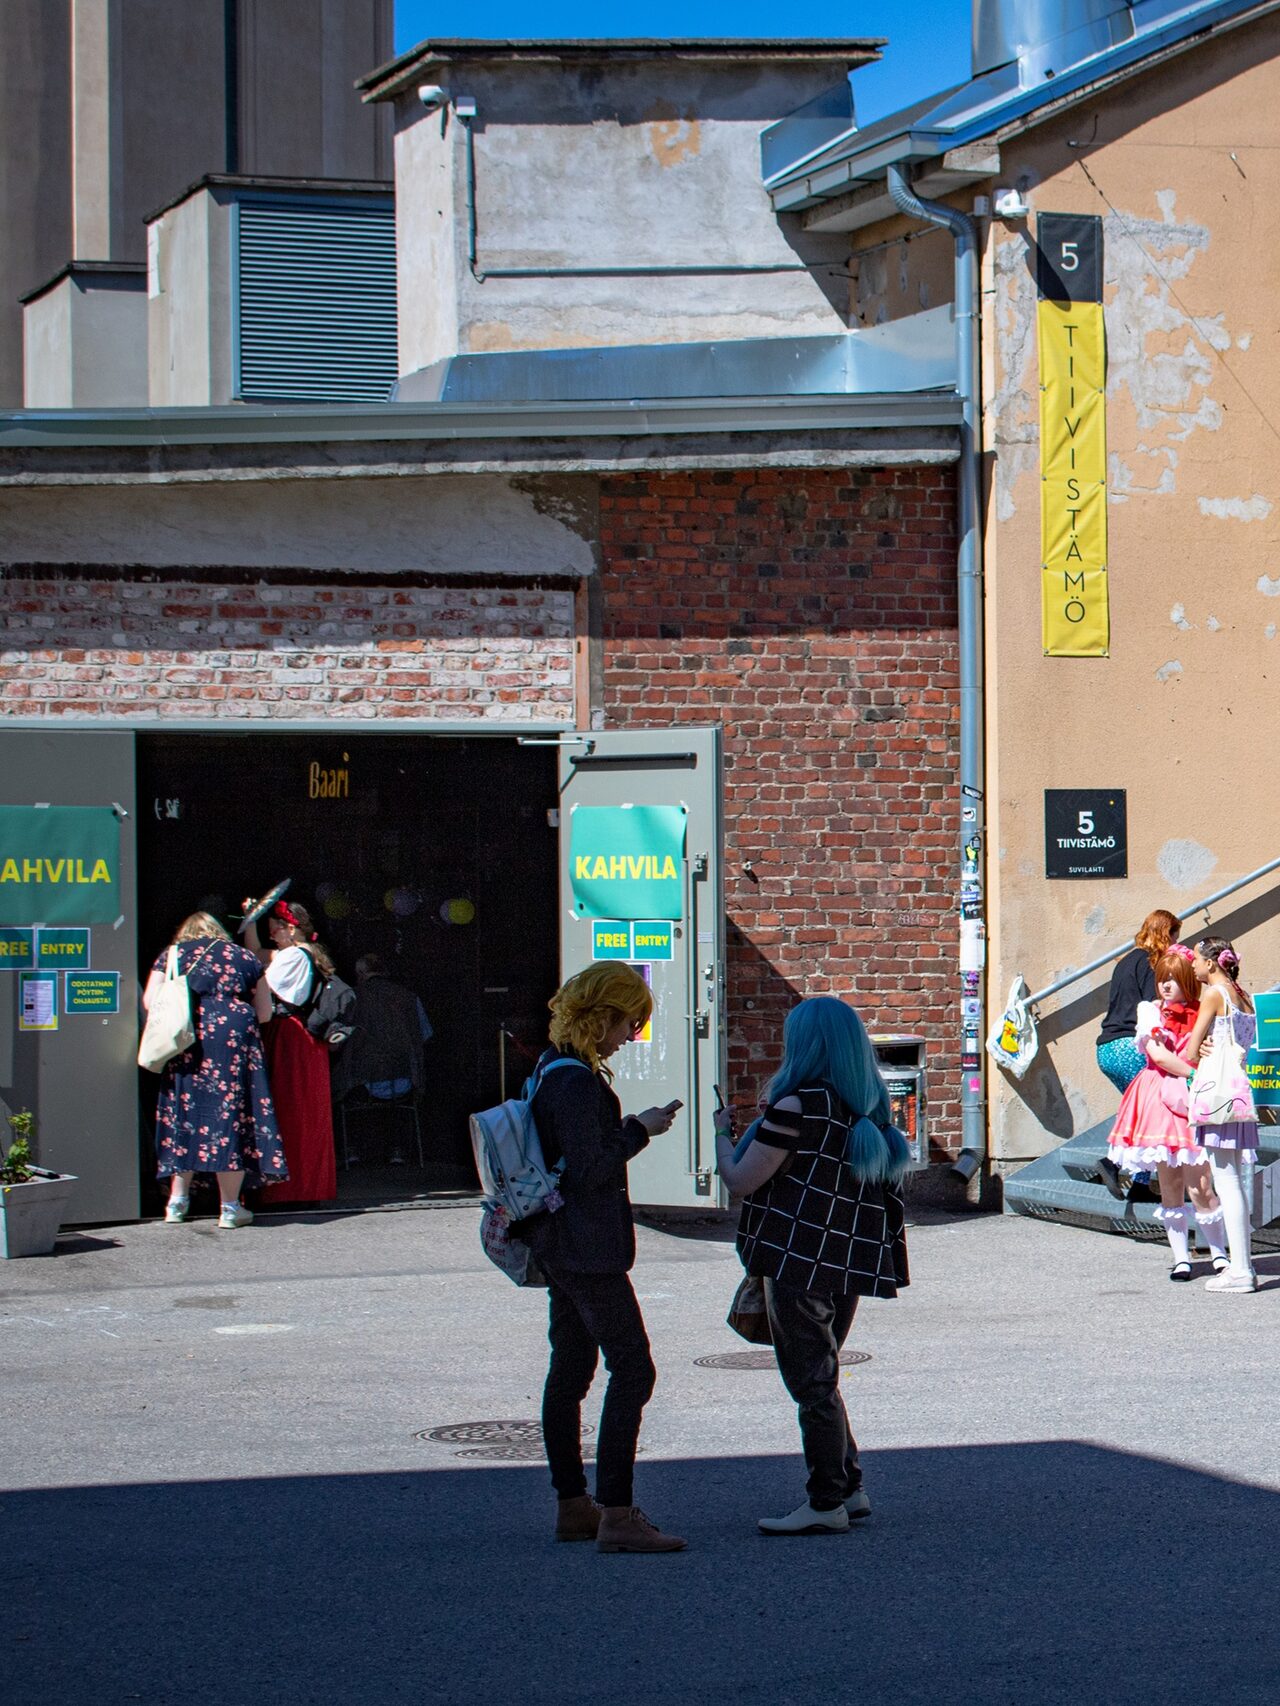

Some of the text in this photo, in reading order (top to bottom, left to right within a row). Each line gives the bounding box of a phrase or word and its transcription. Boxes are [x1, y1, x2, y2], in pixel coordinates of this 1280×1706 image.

[1060, 242, 1079, 272] 5
[1062, 325, 1086, 623] TIIVISTÄMÖ
[309, 751, 350, 799] Baari
[1077, 811, 1095, 835] 5
[1056, 836, 1116, 849] TIIVISTÄMÖ
[0, 857, 112, 884] AHVILA
[575, 855, 678, 880] KAHVILA
[1068, 866, 1105, 874] SUVILAHTI
[0, 941, 84, 957] REE ENTRY
[596, 933, 669, 948] FREE ENTRY
[1246, 1064, 1275, 1075] LIPUT
